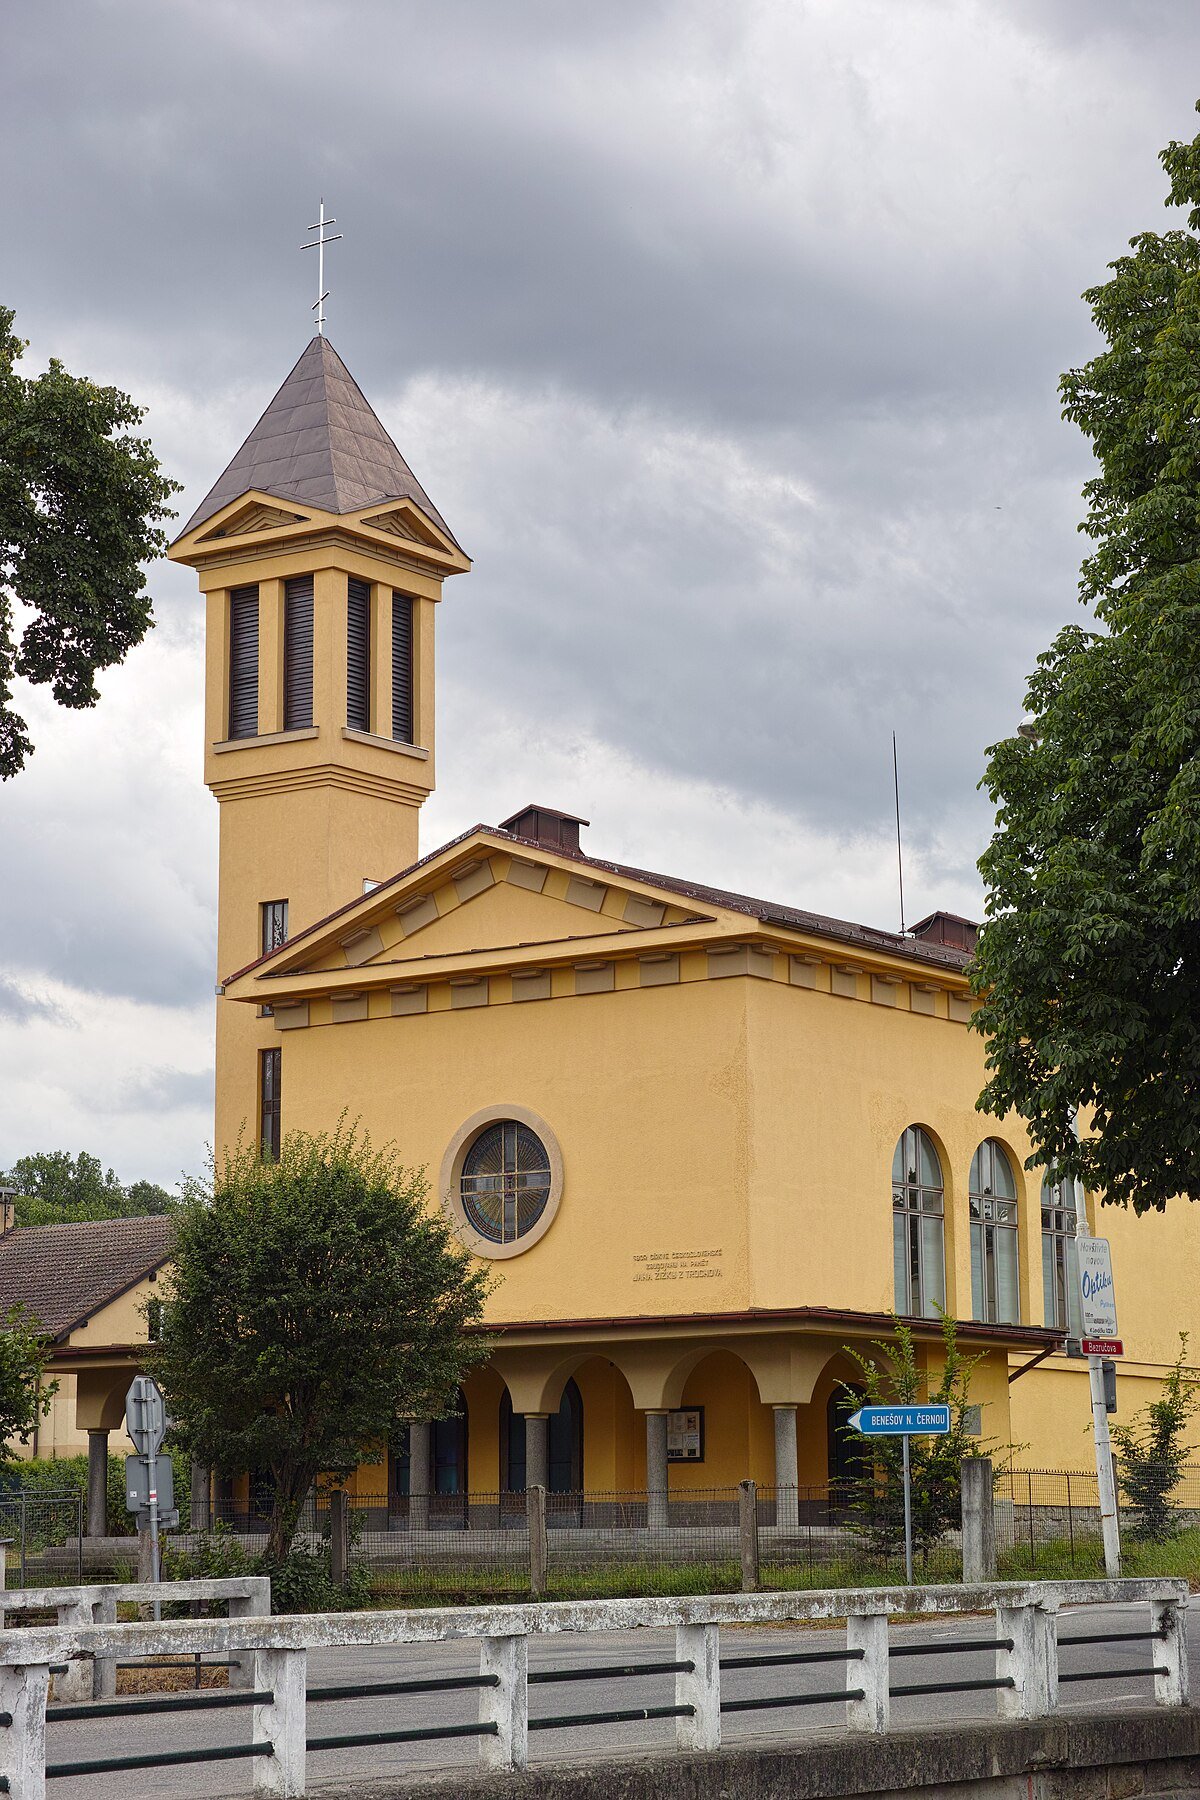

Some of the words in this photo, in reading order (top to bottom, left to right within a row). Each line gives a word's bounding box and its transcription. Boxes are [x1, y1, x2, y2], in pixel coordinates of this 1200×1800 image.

[1085, 1256, 1105, 1265] novou
[632, 1272, 653, 1282] JANA
[678, 1271, 684, 1279] Z
[1088, 1342, 1117, 1353] Bezručova
[871, 1413, 903, 1426] BENEŠOV
[906, 1415, 914, 1425] N.
[916, 1412, 945, 1425] ČERNOU
